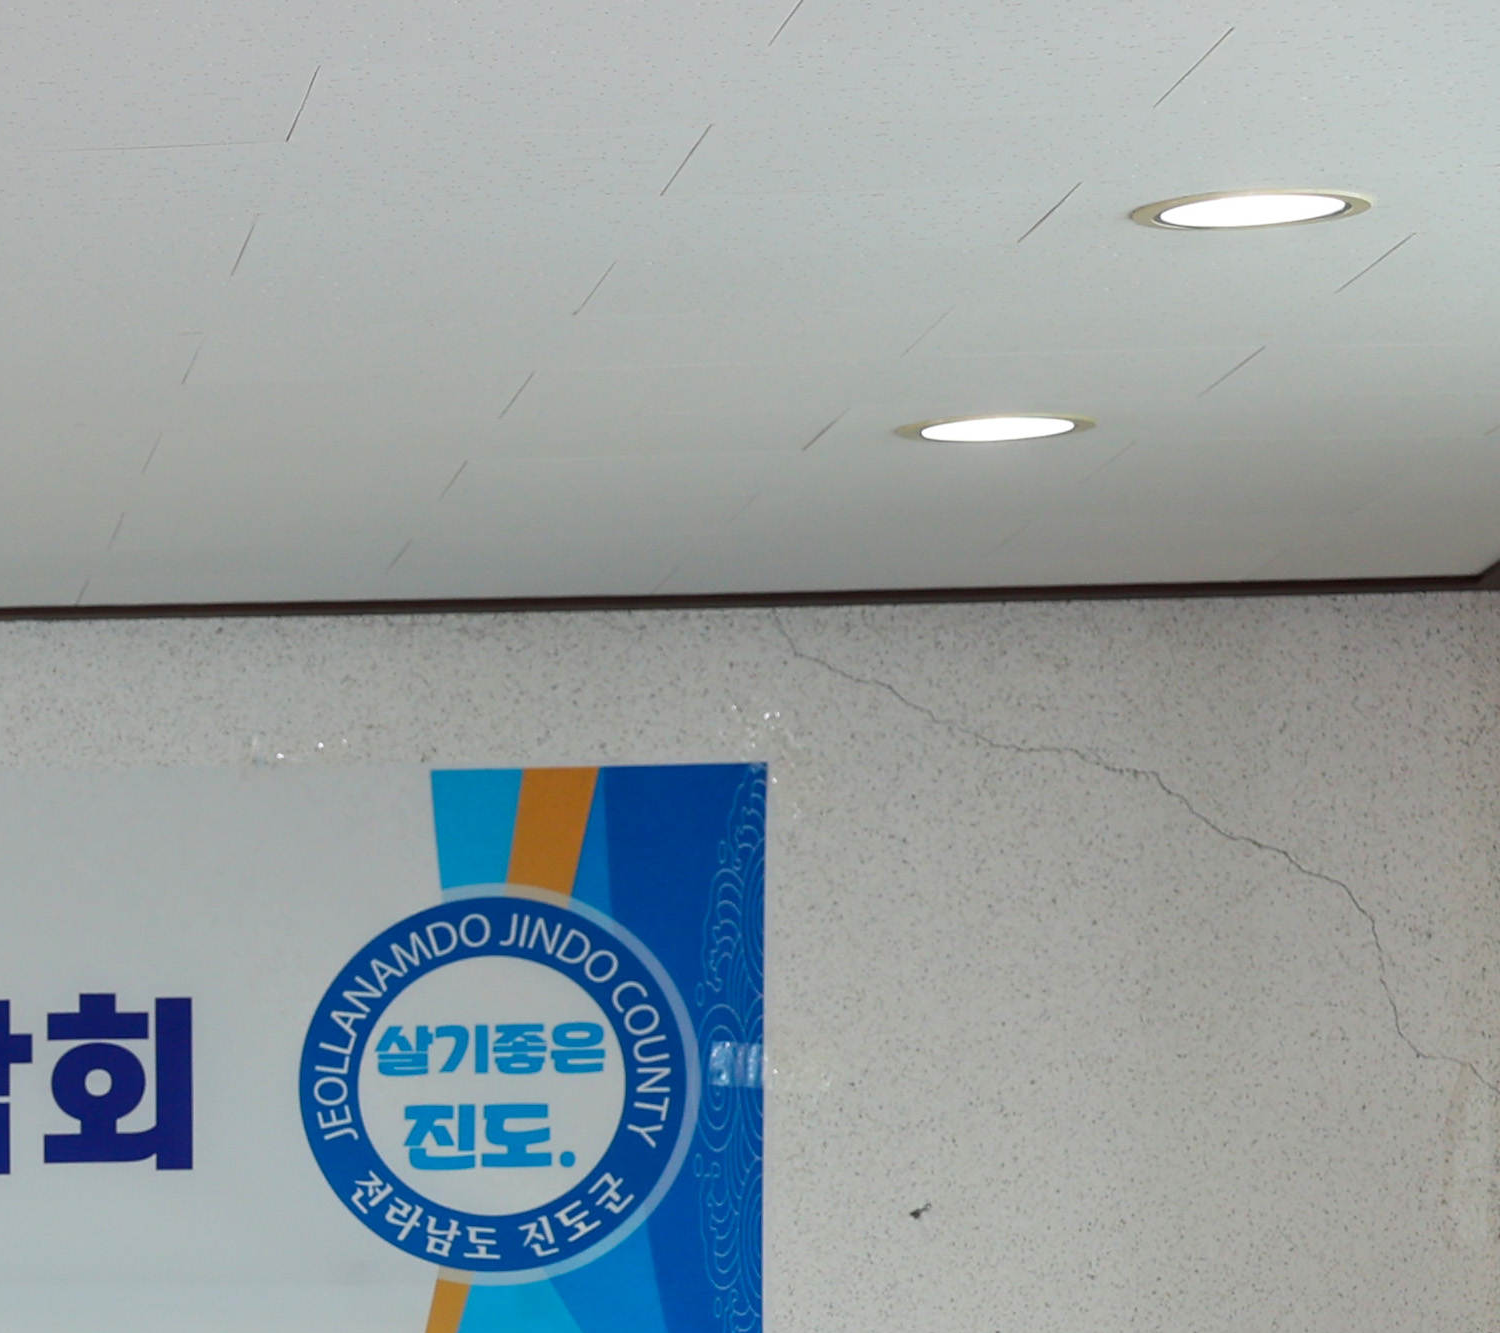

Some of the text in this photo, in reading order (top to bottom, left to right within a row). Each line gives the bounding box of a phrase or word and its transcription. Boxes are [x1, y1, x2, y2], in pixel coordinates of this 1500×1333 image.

[313, 913, 673, 1149] JEOLLANAMDO JINDO COUNTY
[373, 1021, 606, 1077] 살기좋은
[403, 1103, 577, 1171] 진도.
[350, 1170, 635, 1260] 전라남도 진도군
